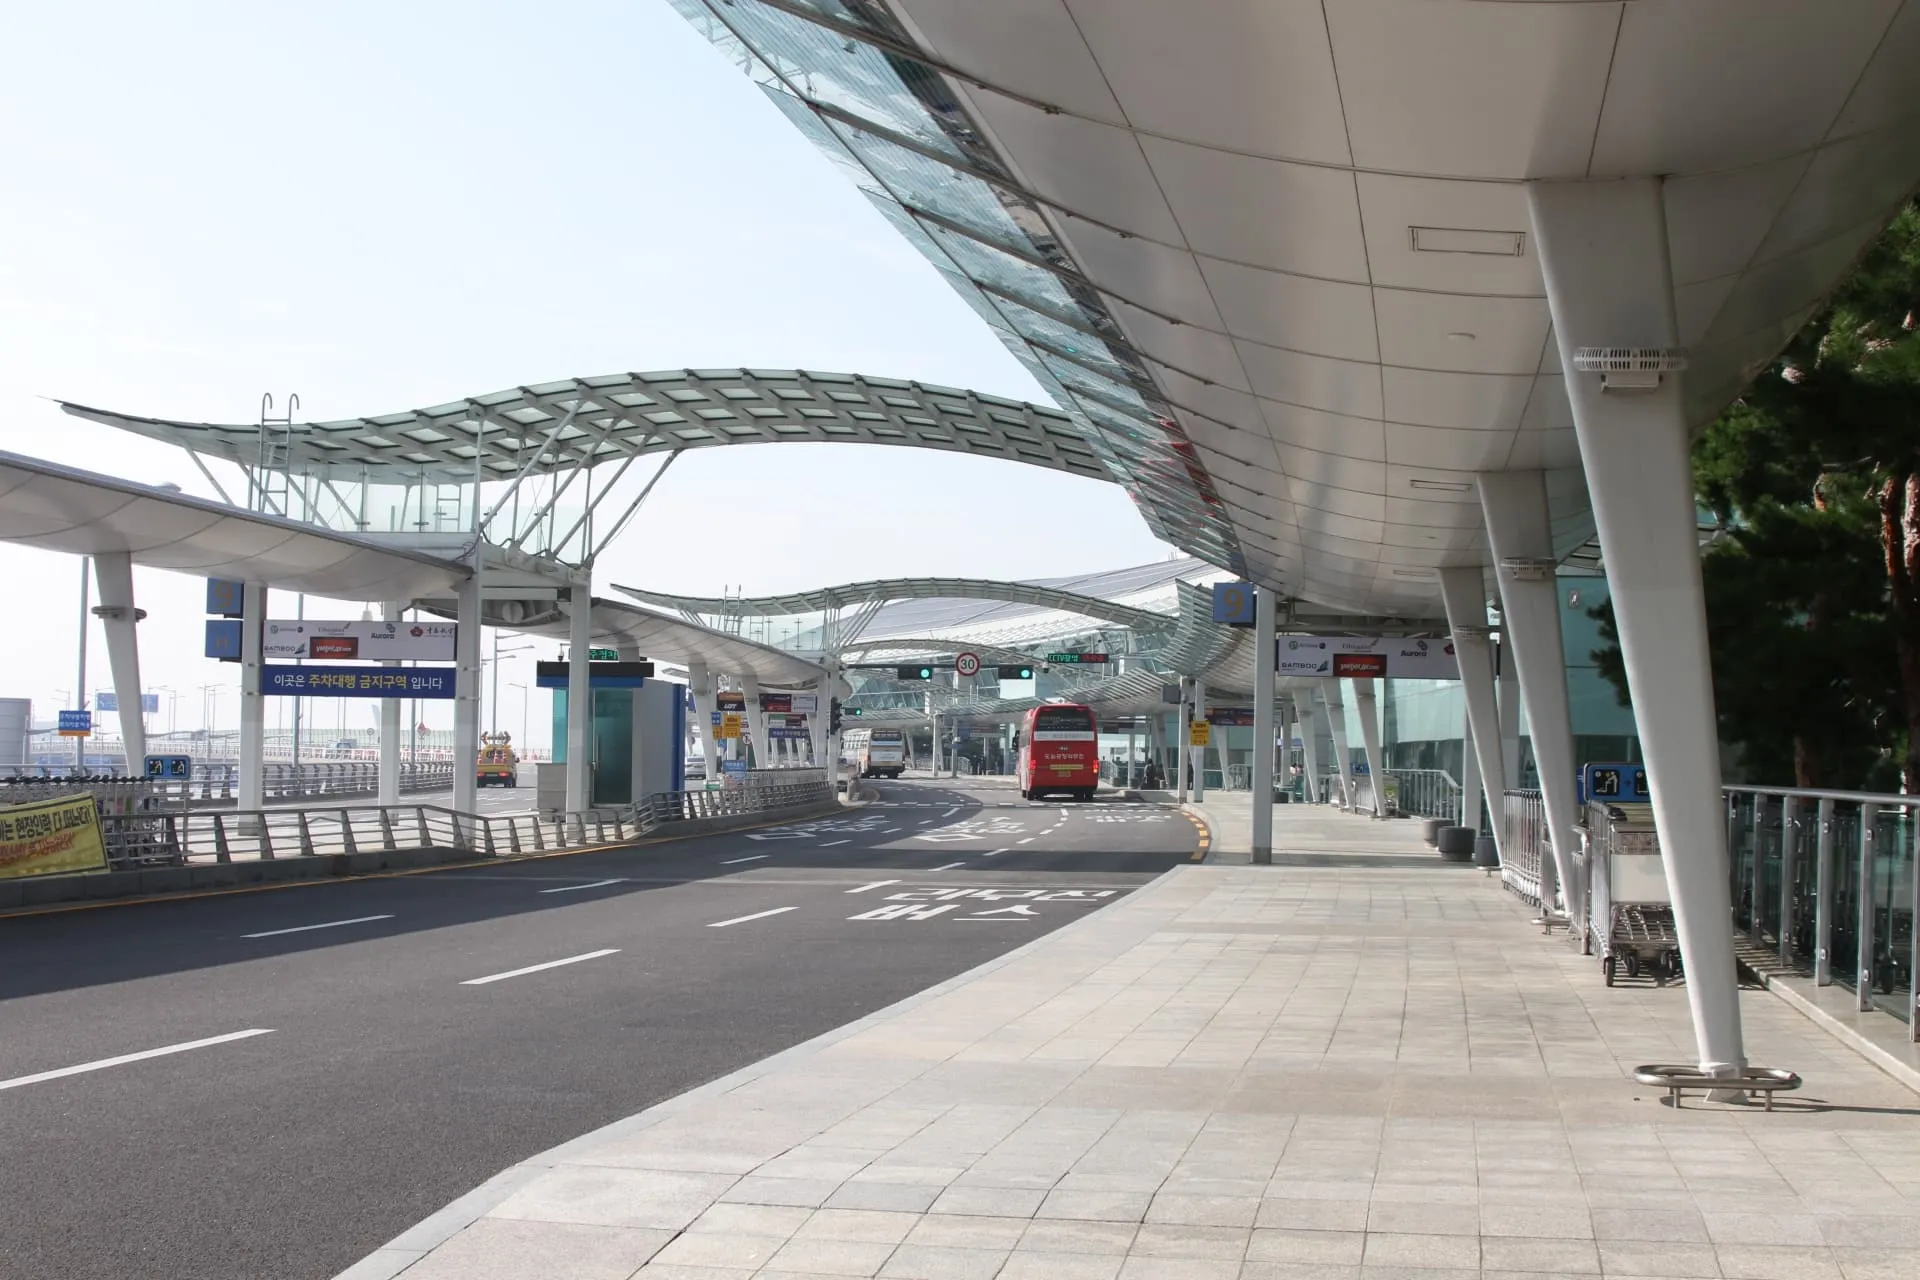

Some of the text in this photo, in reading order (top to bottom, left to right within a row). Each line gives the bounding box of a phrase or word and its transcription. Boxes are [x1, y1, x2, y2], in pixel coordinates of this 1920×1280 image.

[1224, 588, 1244, 618] 9
[1401, 649, 1427, 657] Aurora
[960, 658, 975, 670] 30
[274, 674, 443, 690] 이곳은 주차대행 금지구역 입니다
[883, 888, 1118, 902] 리무진
[845, 904, 1041, 921] 버스
